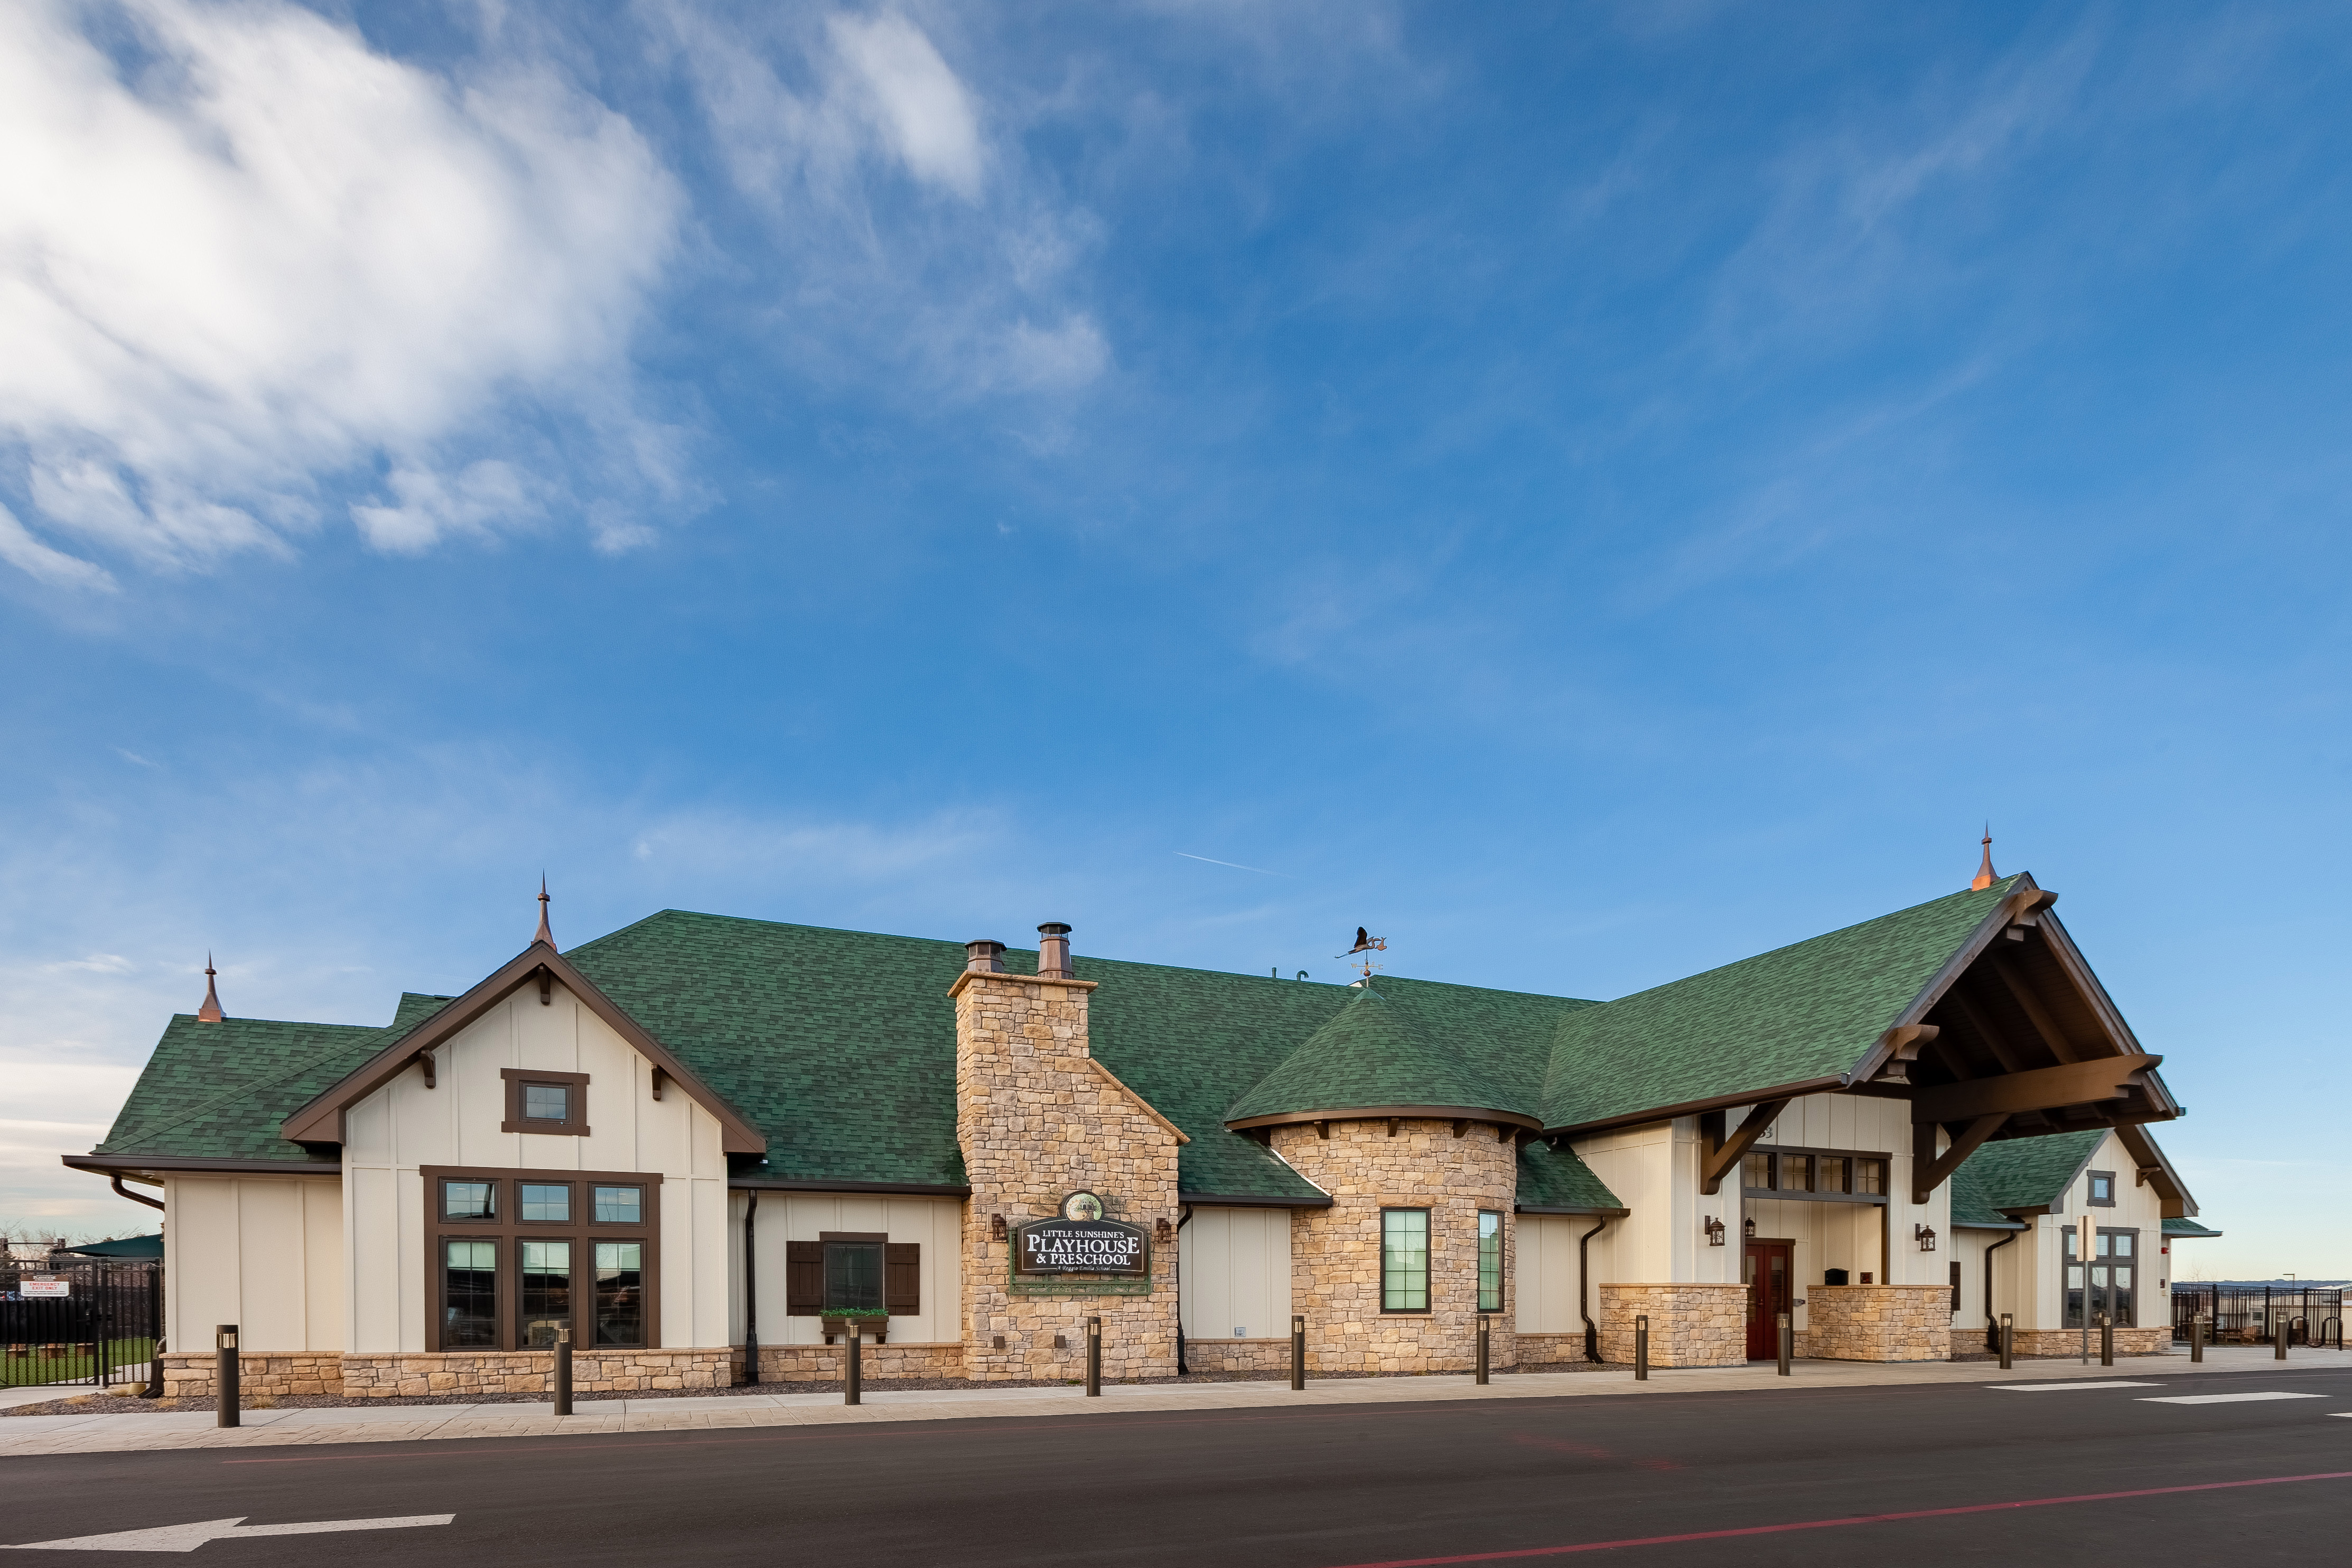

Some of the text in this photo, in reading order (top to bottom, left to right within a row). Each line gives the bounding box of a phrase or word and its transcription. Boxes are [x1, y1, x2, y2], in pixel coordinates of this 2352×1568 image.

[1026, 1234, 1140, 1254] PLAYHOUSE
[1036, 1253, 1131, 1265] & PRESCHOOL
